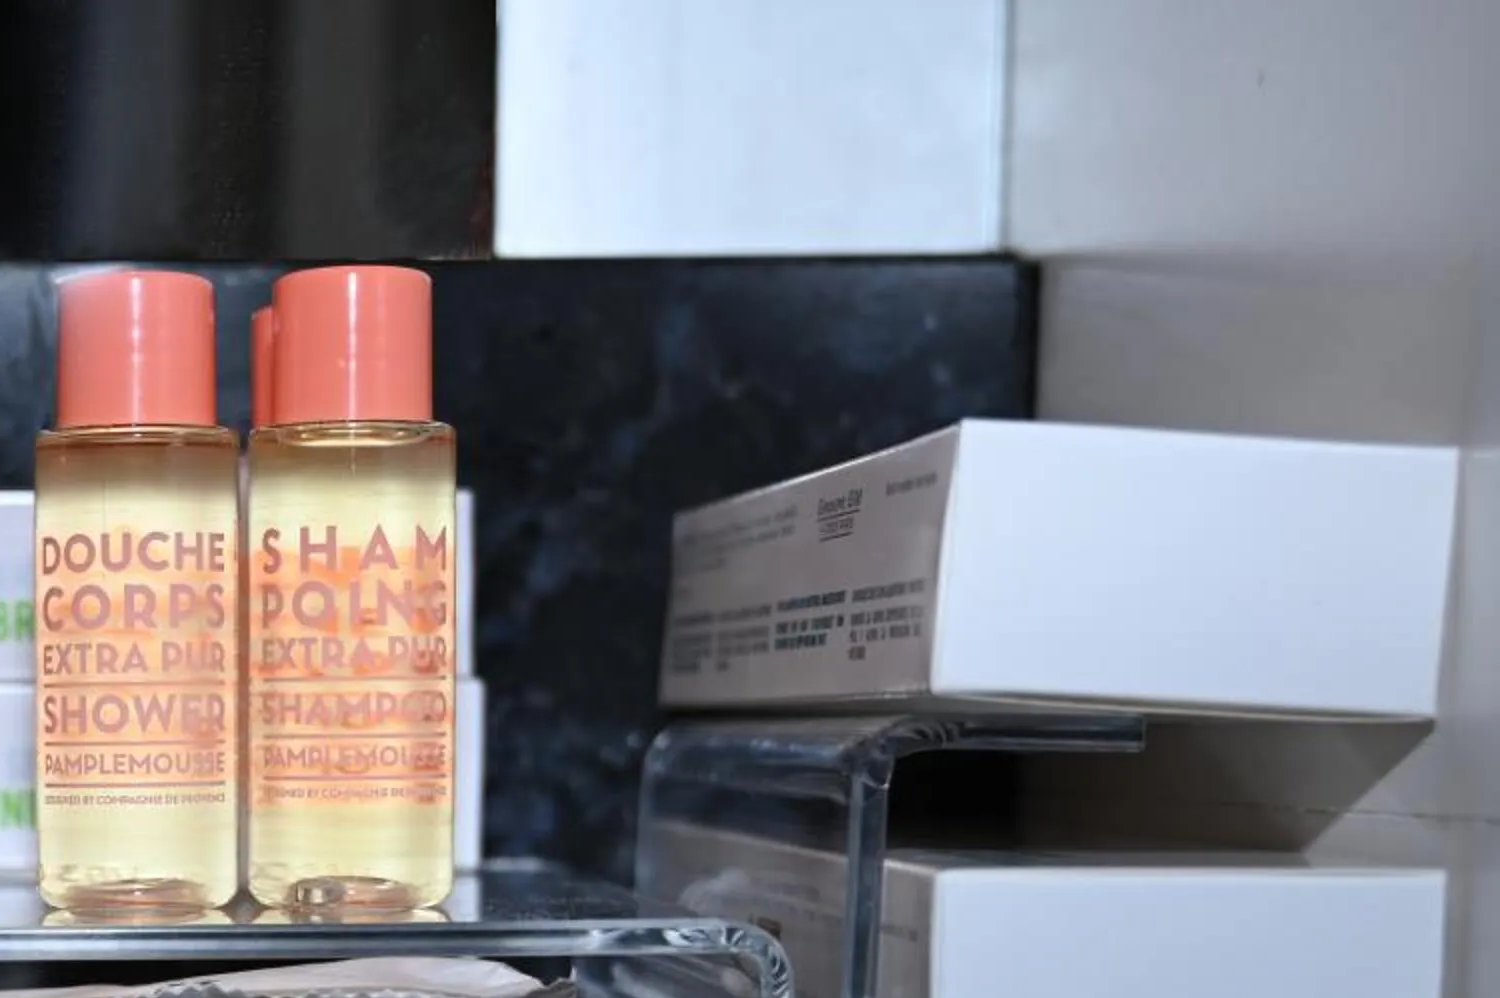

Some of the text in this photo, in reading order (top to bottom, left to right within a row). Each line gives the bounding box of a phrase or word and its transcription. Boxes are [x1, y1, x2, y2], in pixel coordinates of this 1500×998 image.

[42, 532, 225, 574] DOUCHE
[262, 524, 447, 574] SHAM
[42, 584, 225, 632] CORPS
[262, 580, 447, 632] POING
[43, 641, 225, 676] EXTRA PUR
[262, 635, 446, 669] EXTRA PUR
[44, 693, 225, 735] SHOWER
[262, 690, 446, 725] SHAMPOO
[45, 751, 225, 774] PAMPLEMOUSSE
[263, 744, 447, 769] PAMPLEMOUE
